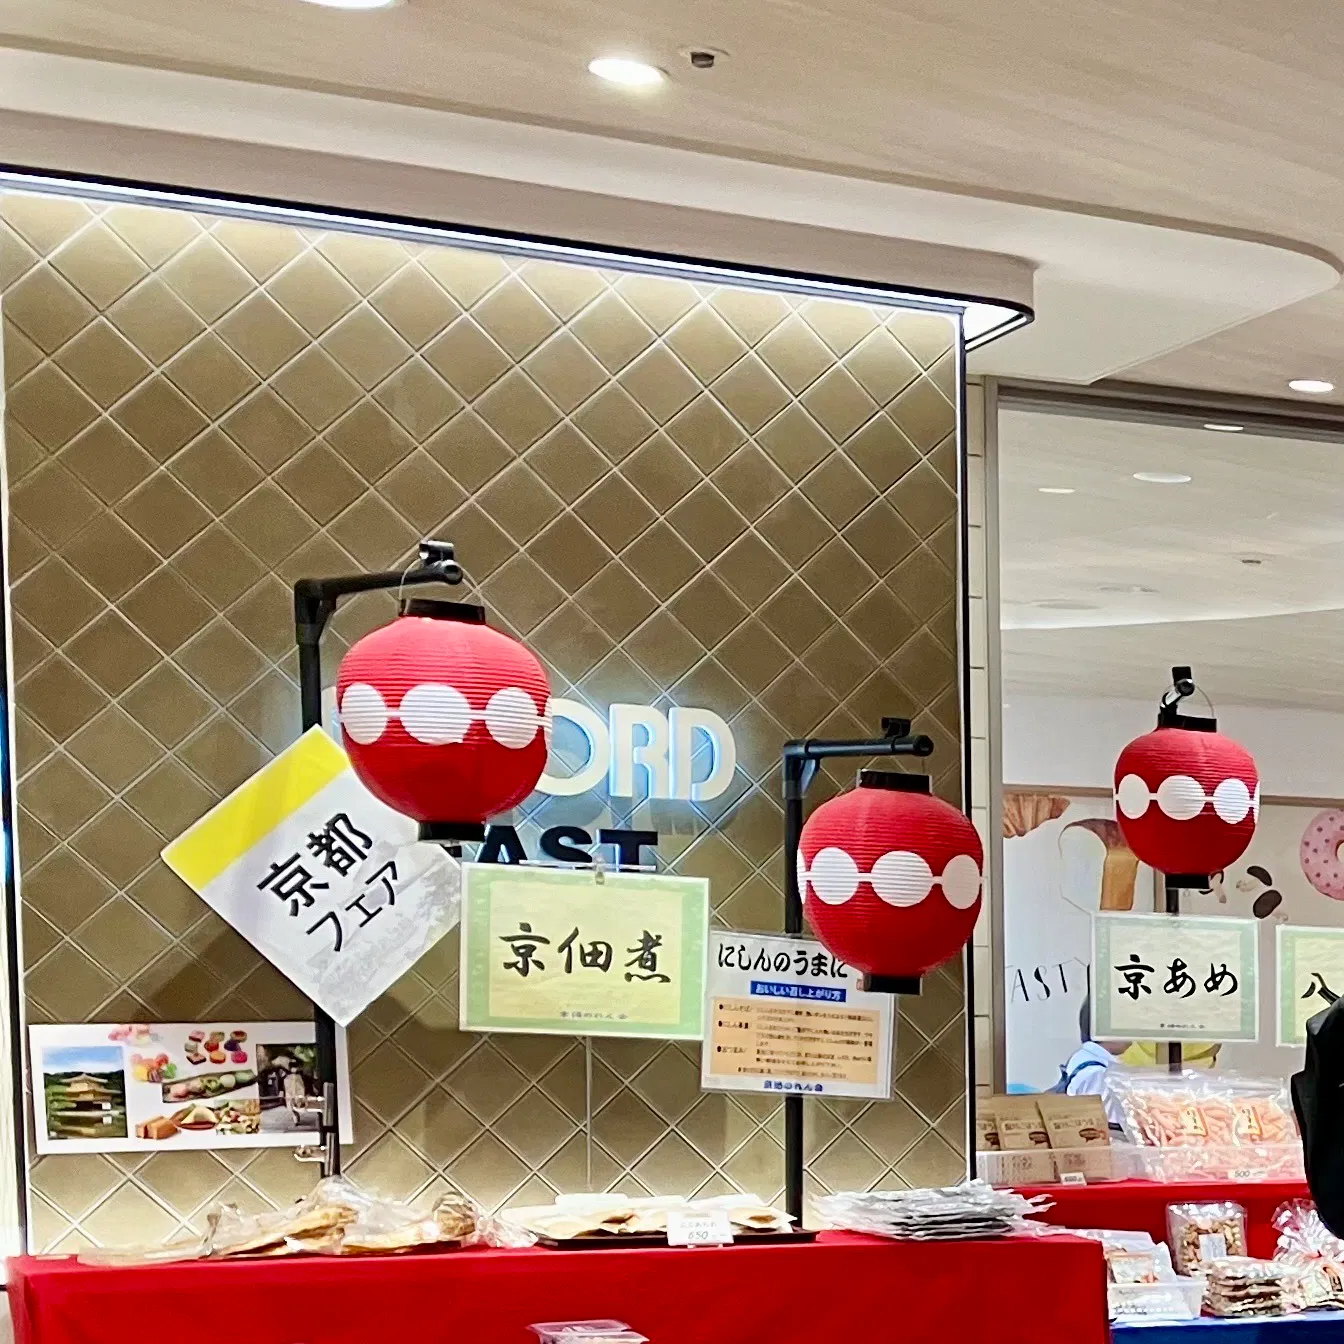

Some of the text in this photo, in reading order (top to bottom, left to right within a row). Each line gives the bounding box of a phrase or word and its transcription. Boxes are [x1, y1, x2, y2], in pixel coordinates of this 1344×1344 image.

[257, 813, 373, 917] 京都
[477, 825, 658, 872] AST
[306, 861, 398, 952] フェア
[498, 922, 671, 983] 京佃煮
[718, 943, 848, 979] にしんのうまに
[1006, 957, 1091, 1004] ASTY
[1114, 953, 1239, 1001] 京あめ
